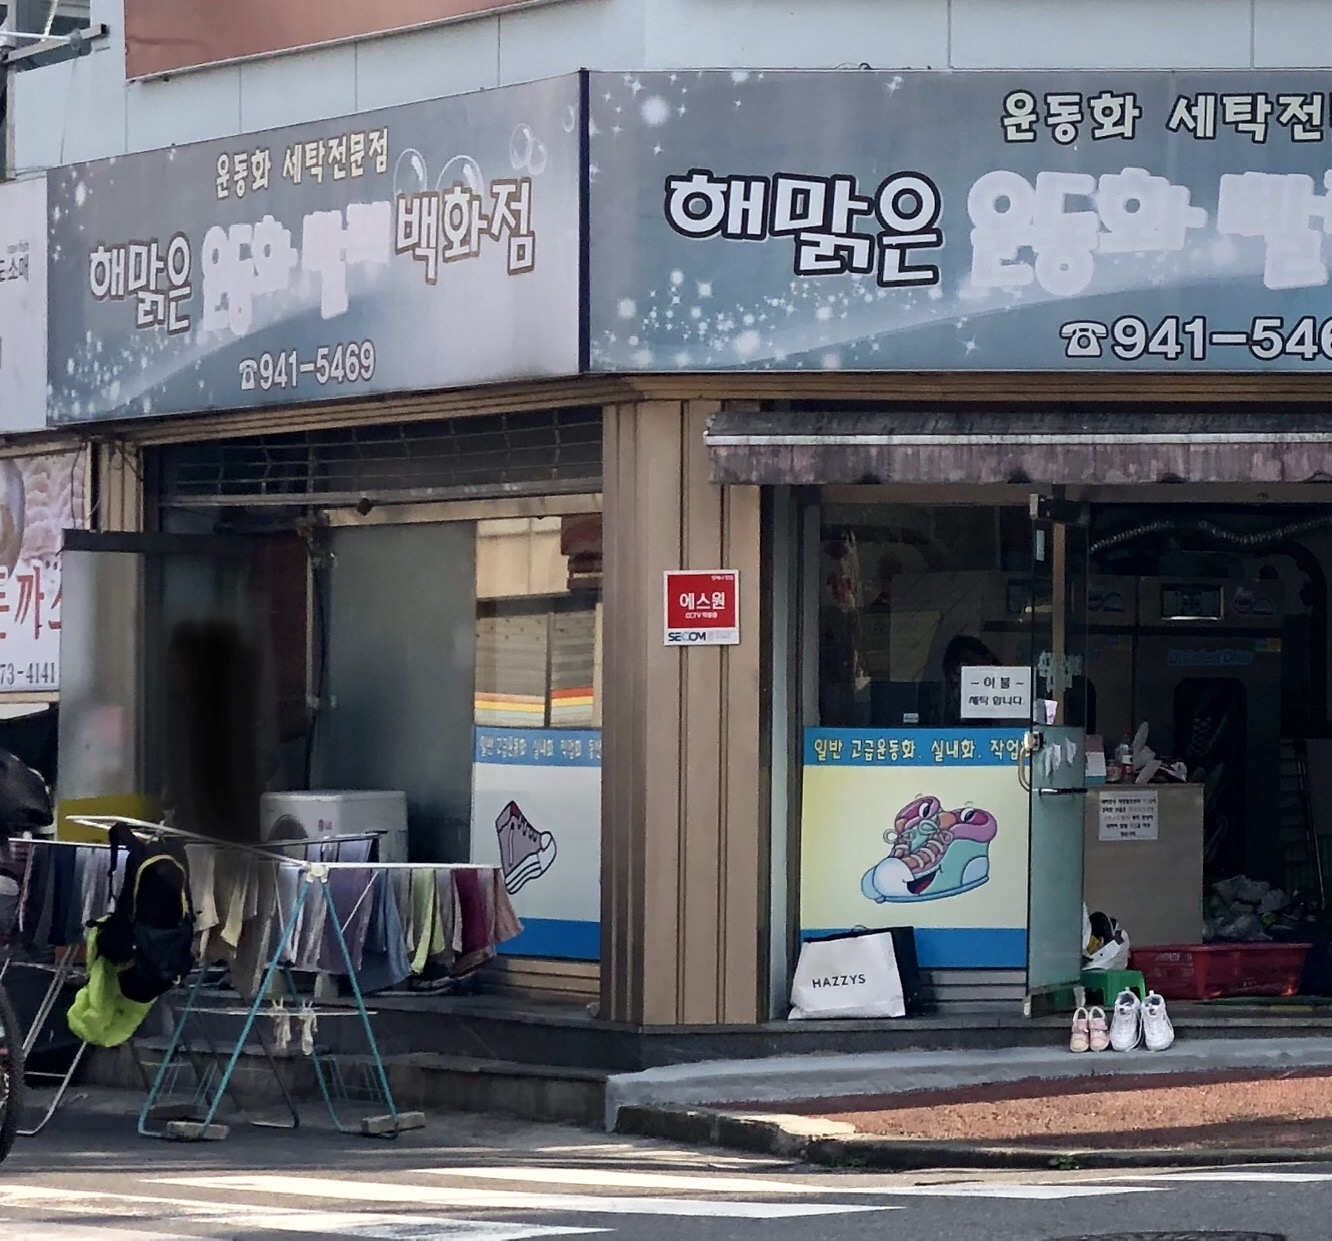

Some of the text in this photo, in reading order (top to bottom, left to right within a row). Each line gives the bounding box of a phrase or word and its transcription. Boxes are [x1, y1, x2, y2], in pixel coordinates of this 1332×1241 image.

[1002, 90, 1142, 144] 운동화
[215, 127, 389, 200] 운동화 세탁전문점
[665, 169, 943, 288] 해맑은
[89, 230, 192, 336] 해맑은
[395, 177, 536, 284] 백화점
[259, 339, 377, 390] 941-5469
[679, 591, 725, 610] 에스원
[668, 631, 707, 642] SECOM
[814, 738, 843, 761] 일반
[812, 973, 867, 989] HAZZYS
